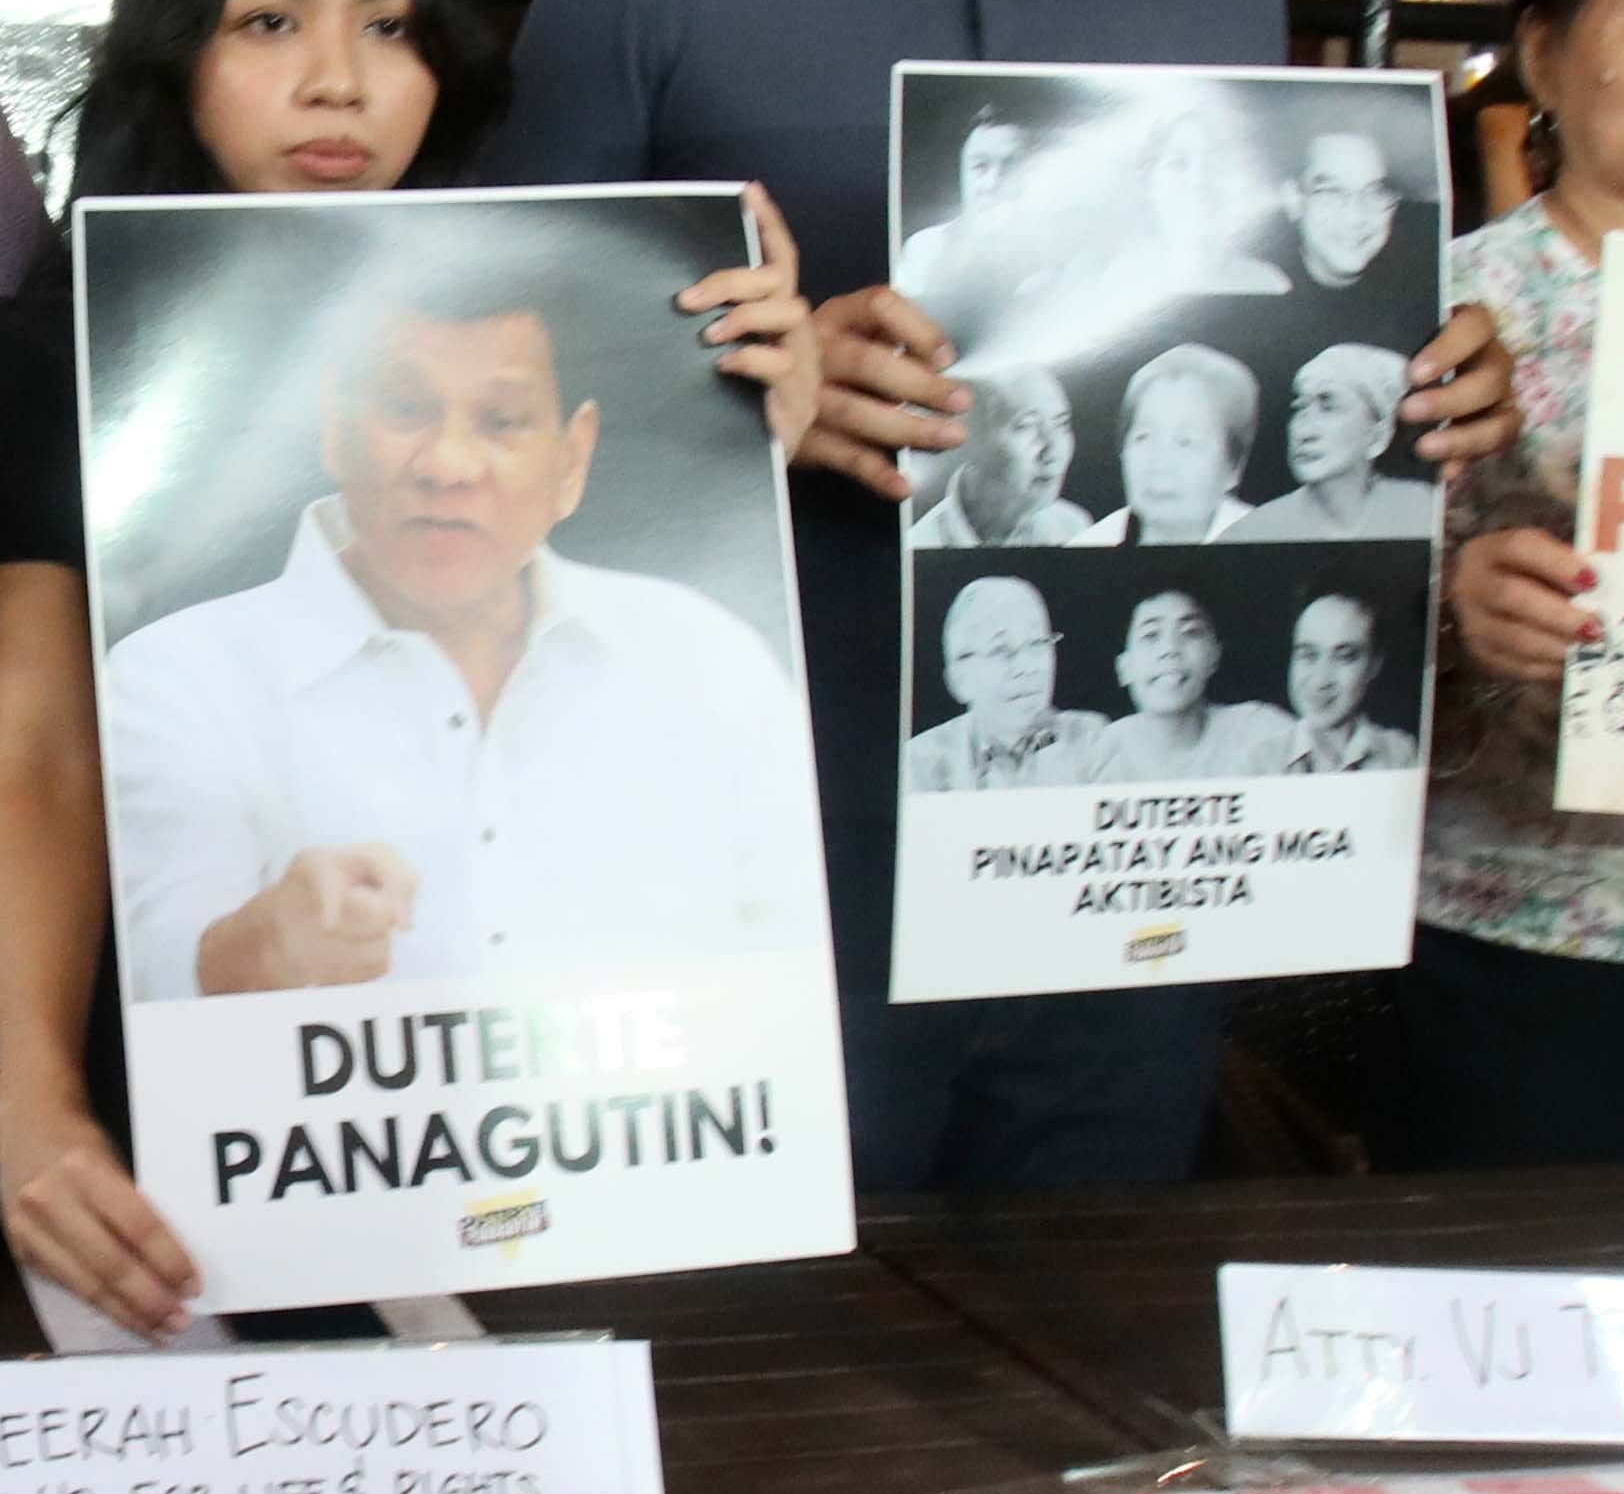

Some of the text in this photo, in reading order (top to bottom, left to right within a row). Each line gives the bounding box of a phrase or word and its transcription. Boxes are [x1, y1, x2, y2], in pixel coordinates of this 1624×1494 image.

[1093, 792, 1248, 833] DUTERTE
[968, 826, 1356, 881] PINAPATAY ANG MGA
[1070, 875, 1257, 917] AKTIBISTA
[211, 1077, 780, 1206] PANAGUTIN!
[225, 1371, 549, 1459] ESCUDERO
